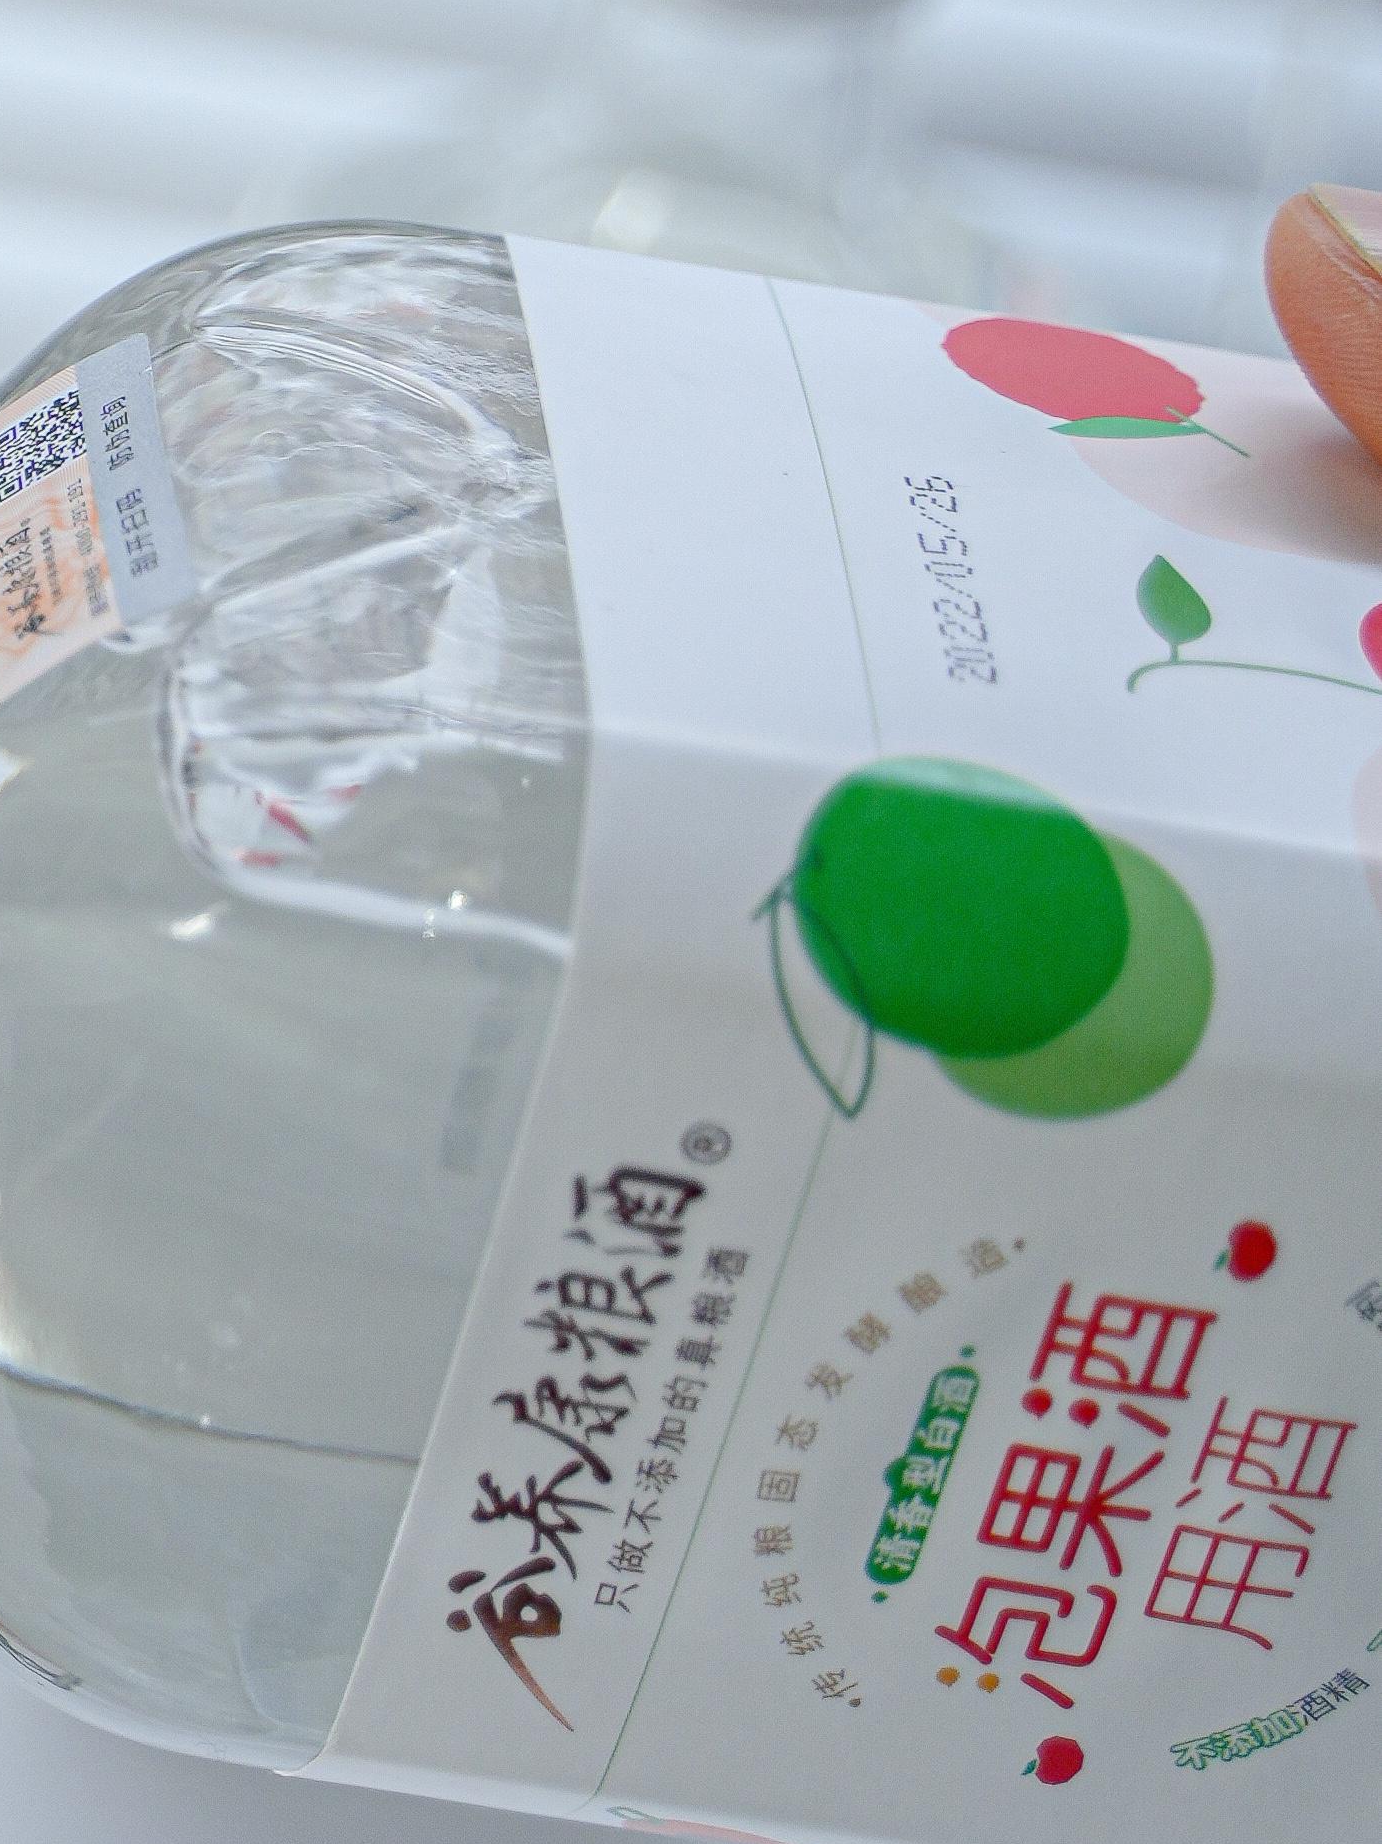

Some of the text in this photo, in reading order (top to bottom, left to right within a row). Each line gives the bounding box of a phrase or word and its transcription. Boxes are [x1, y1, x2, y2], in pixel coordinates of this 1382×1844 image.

[98, 395, 135, 472] 防伪查询
[903, 474, 998, 686] 2022/05/26
[592, 1244, 753, 1615] 只做不添加的真粮酒
[870, 1368, 980, 1577] 清香型白酒
[934, 1280, 1218, 1711] 泡果酒
[1144, 1396, 1358, 1650] 用酒
[1169, 1666, 1372, 1771] 不添加酒精
